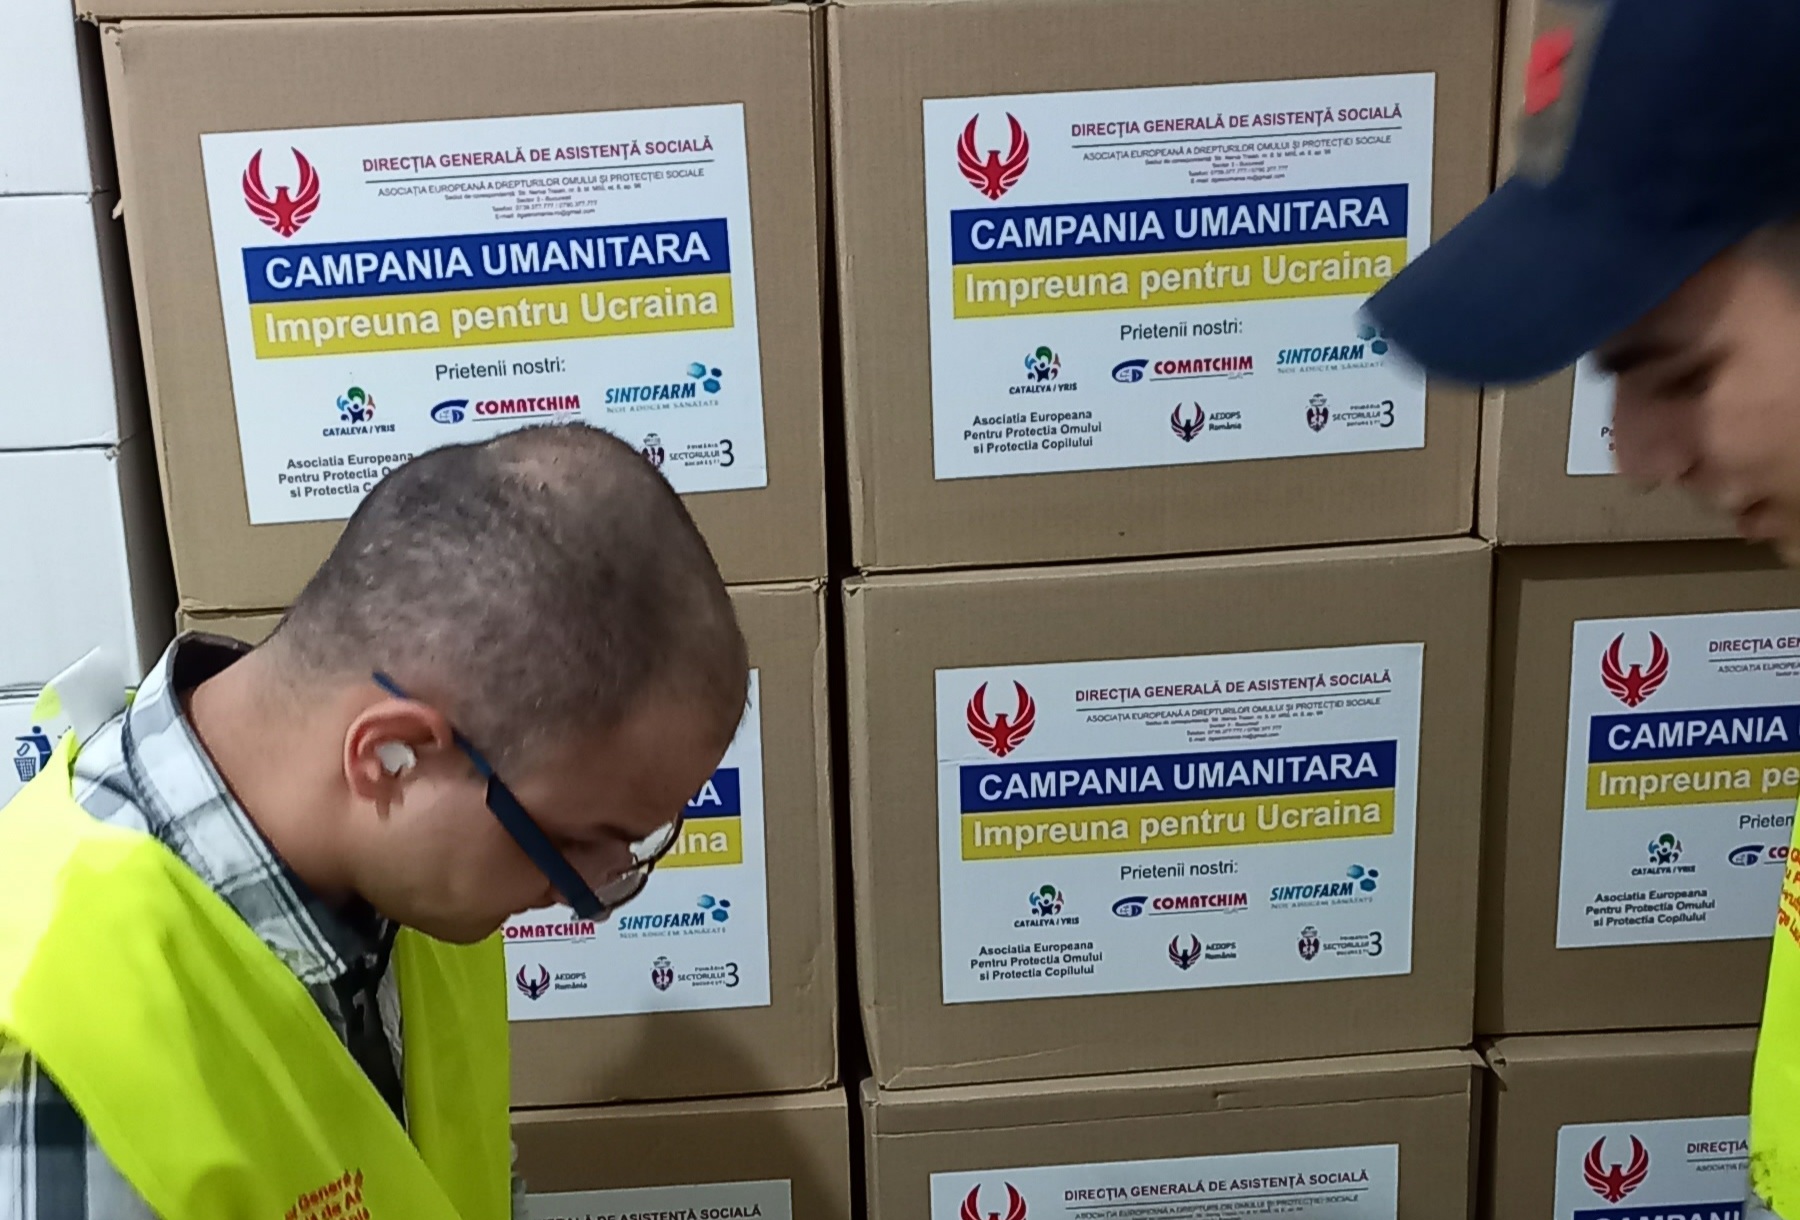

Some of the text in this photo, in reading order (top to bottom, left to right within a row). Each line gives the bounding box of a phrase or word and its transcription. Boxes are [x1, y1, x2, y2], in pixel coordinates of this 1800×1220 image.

[1229, 115, 1249, 128] DE
[530, 148, 552, 162] DE
[970, 196, 1389, 250] CAMPANIA UMANITARA
[264, 231, 710, 289] CAMPANIA UMANITARA
[966, 250, 1392, 307] Impreuna pentru Ucraina
[265, 287, 719, 348] Impreuna pentru Ucraina
[1120, 318, 1242, 340] Prietenii nostri:
[1276, 344, 1364, 365] SINTOFARM
[435, 356, 566, 381] Prietenii nostri:
[1153, 355, 1253, 375] COMATCHIM
[604, 383, 696, 404] SINTOFARM
[474, 394, 581, 416] COMATCHIM
[1379, 399, 1395, 428] 3
[972, 408, 1092, 426] Asociatia Europeana
[963, 421, 1101, 440] Pentru Protectia Omului
[718, 439, 735, 468] 3
[973, 436, 1092, 454] si Protectia Copilului
[286, 450, 414, 469] Asociatia Europeana
[278, 472, 320, 484] Pentru
[322, 467, 378, 481] Protectia
[290, 487, 301, 498] si
[304, 483, 360, 497] Protectia
[1226, 681, 1245, 693] DE
[1607, 715, 1789, 750] CAMPANIA
[979, 752, 1379, 801] CAMPANIA UMANITARA
[1599, 769, 1752, 800] Impreuna
[974, 799, 1381, 851] Impreuna pentru Ucraina
[1738, 814, 1794, 829] Prieten
[1121, 860, 1238, 880] Prietenii nostri:
[1152, 892, 1248, 911] COMATCHIM
[1270, 882, 1353, 901] SINTOFARM
[503, 920, 597, 941] OMATCHIM
[618, 913, 705, 930] SINTOFARM
[979, 940, 1093, 956] Asociatia Europeana
[1368, 931, 1383, 956] 3
[971, 952, 1102, 968] Pentru Protectia Omului
[724, 962, 740, 988] 3
[979, 965, 1094, 980] si Protectia Copilului
